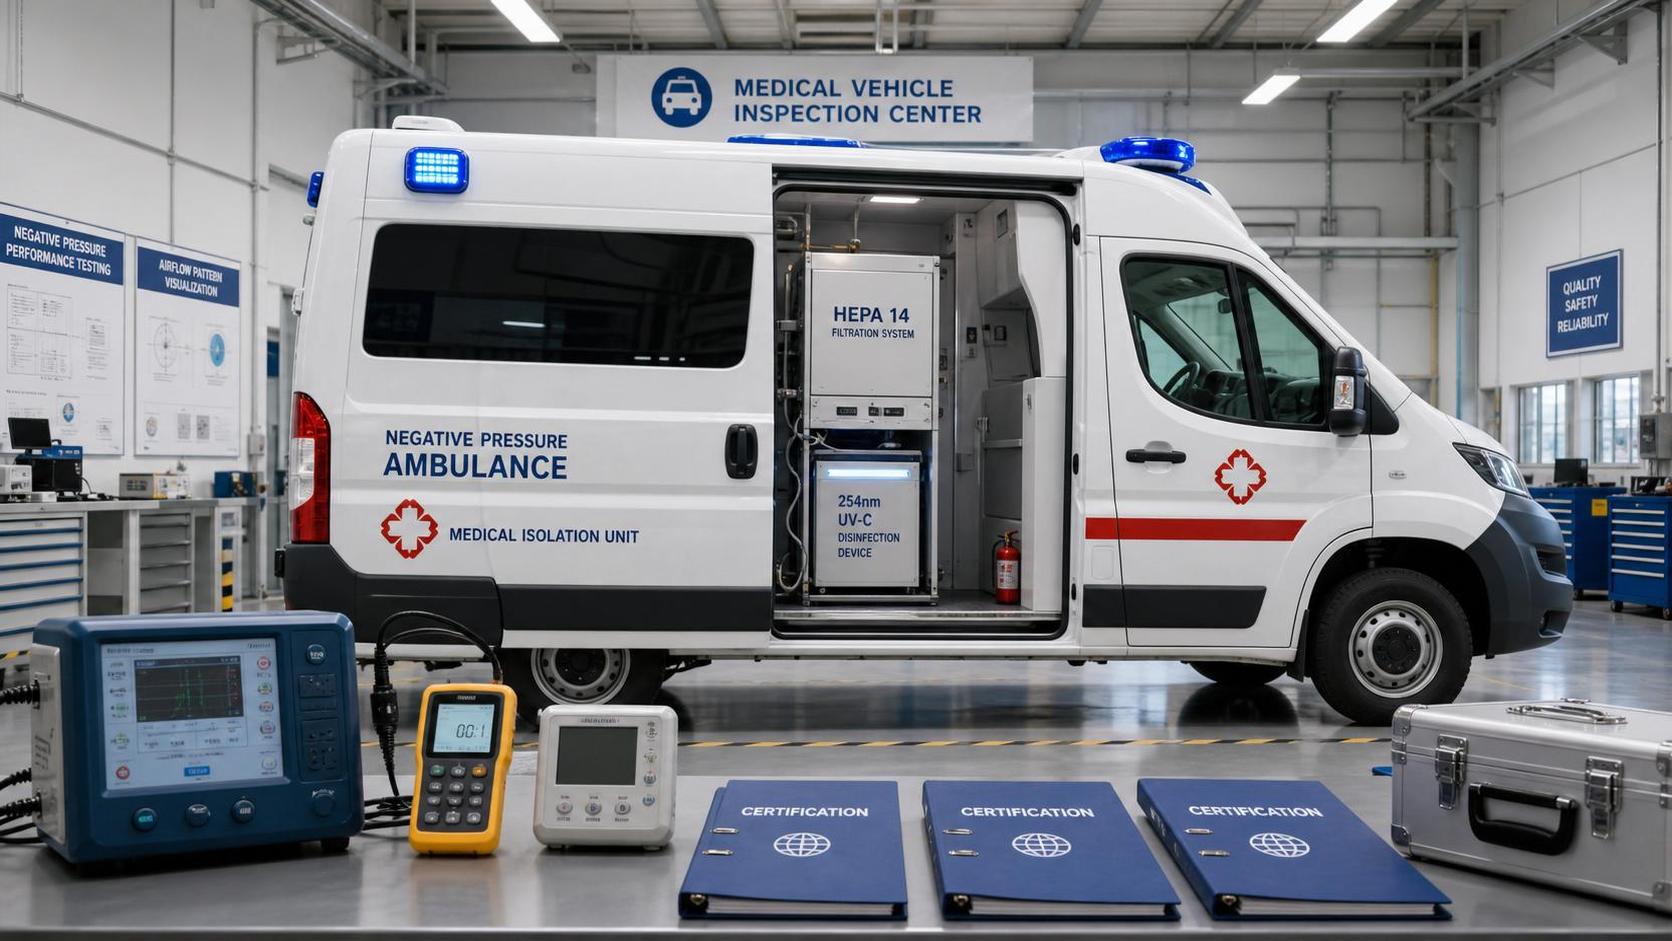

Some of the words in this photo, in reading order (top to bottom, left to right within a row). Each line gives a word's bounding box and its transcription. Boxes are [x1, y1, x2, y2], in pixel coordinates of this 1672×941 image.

[734, 79, 842, 98] MEDICAL
[851, 79, 954, 98] VEHICLE
[734, 104, 879, 123] INSPECTION
[889, 105, 982, 124] CENTER
[14, 225, 61, 248] NEGATIVE
[62, 236, 107, 258] PRESSURE
[6, 242, 75, 269] PERFORMANCE
[76, 257, 111, 276] TESTING
[158, 259, 193, 277] AIRFLOW
[192, 266, 223, 284] PATTERN
[164, 276, 218, 297] VISUALIZATION
[1563, 275, 1602, 296] QUALITY
[1565, 294, 1599, 313] SAFETY
[833, 306, 884, 323] HEPA
[889, 307, 910, 323] 14
[1557, 312, 1609, 333] RELIABILITY
[831, 328, 879, 338] FILTRATION
[881, 328, 915, 339] SYSTEM
[385, 430, 474, 447] NEGATIVE
[480, 432, 568, 449] PRESSURE
[383, 452, 568, 480] AMBULANCE
[838, 494, 881, 508] 254nm
[838, 513, 873, 527] UV-C
[449, 527, 517, 542] MEDICAL
[521, 529, 600, 543] ISOLATION
[604, 530, 639, 543] UNIT
[838, 532, 900, 543] DISINFECTION
[838, 547, 873, 558] DEVICE
[741, 806, 869, 818] CERTIFICATION
[960, 806, 1096, 818] CERTIFICATION
[1188, 805, 1325, 818] CERTIFICATION
